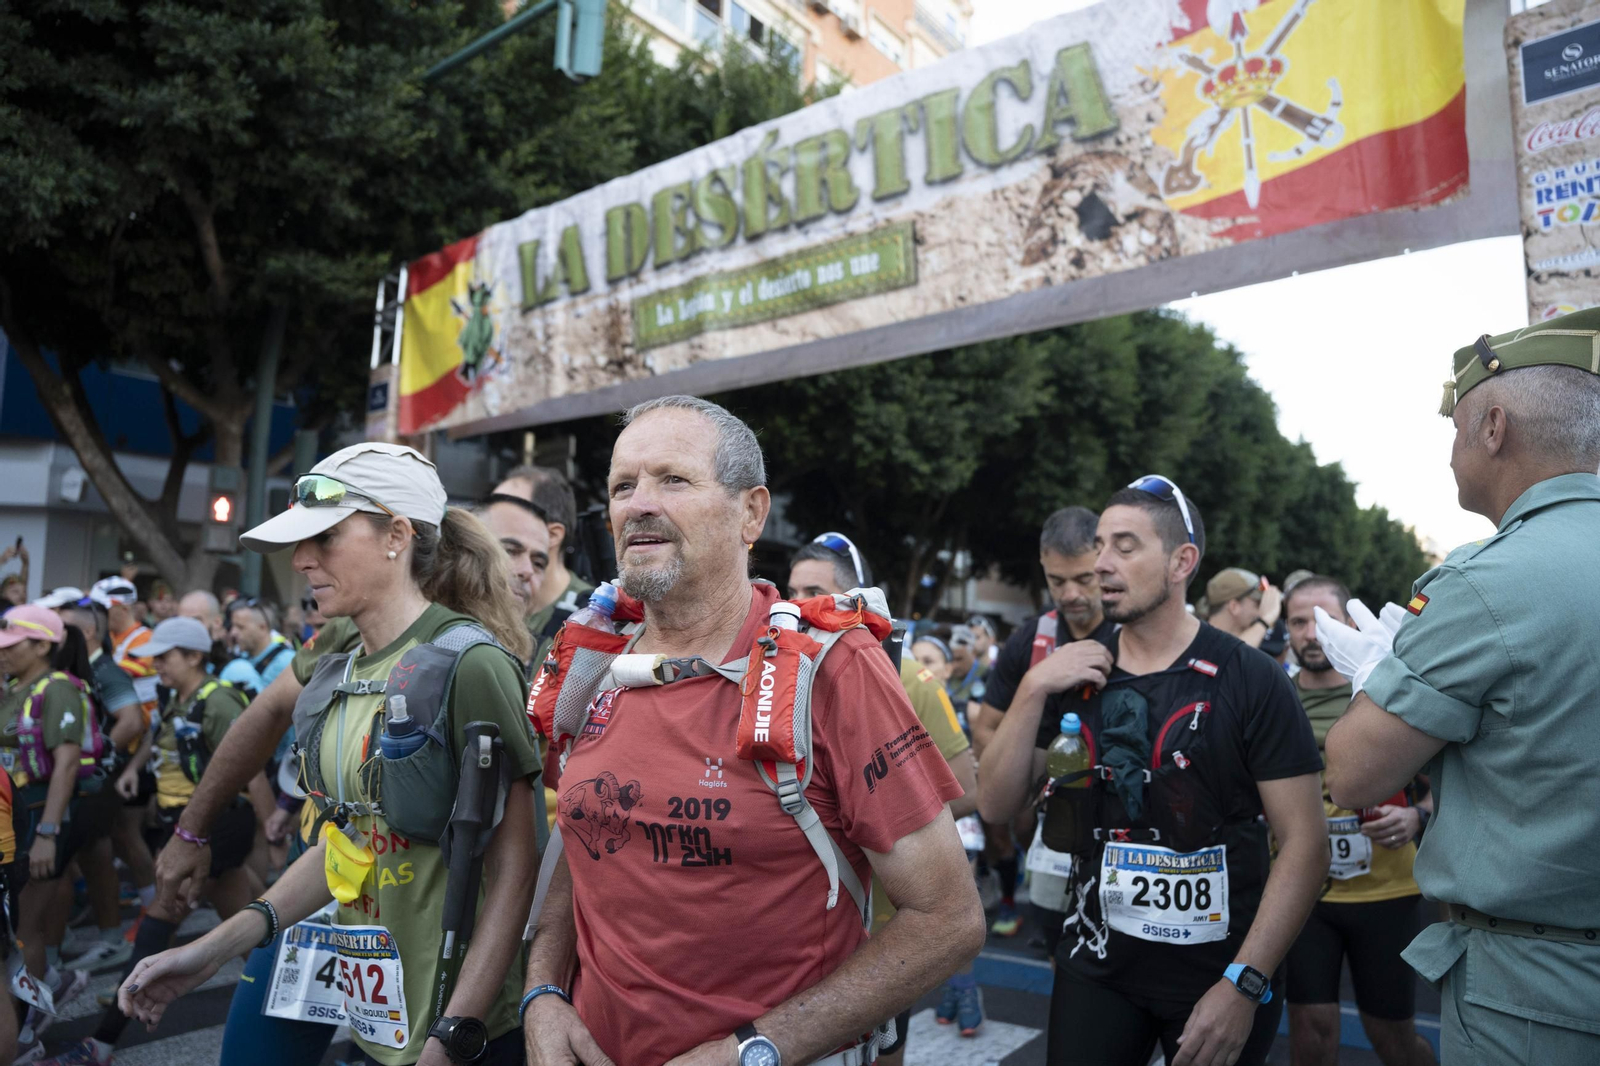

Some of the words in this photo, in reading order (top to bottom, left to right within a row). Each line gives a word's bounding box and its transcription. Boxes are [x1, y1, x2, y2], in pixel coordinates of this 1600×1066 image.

[517, 223, 591, 314] LA
[604, 41, 1121, 284] DESÉRTICA
[1535, 159, 1600, 185] GRU
[655, 303, 674, 327] La
[721, 289, 735, 314] y
[739, 281, 753, 306] el
[757, 269, 813, 302] desierto
[816, 260, 845, 286] nos
[850, 252, 880, 277] une
[754, 660, 777, 743] AONIJIE
[698, 778, 728, 789] Haglöfs
[668, 796, 732, 821] 2019
[1127, 851, 1143, 866] LA
[1146, 851, 1217, 868] DESÉRTICA
[1131, 876, 1212, 912] 2308
[1142, 923, 1181, 939] asisa
[339, 958, 389, 1005] 512
[435, 983, 447, 1017] Quechua
